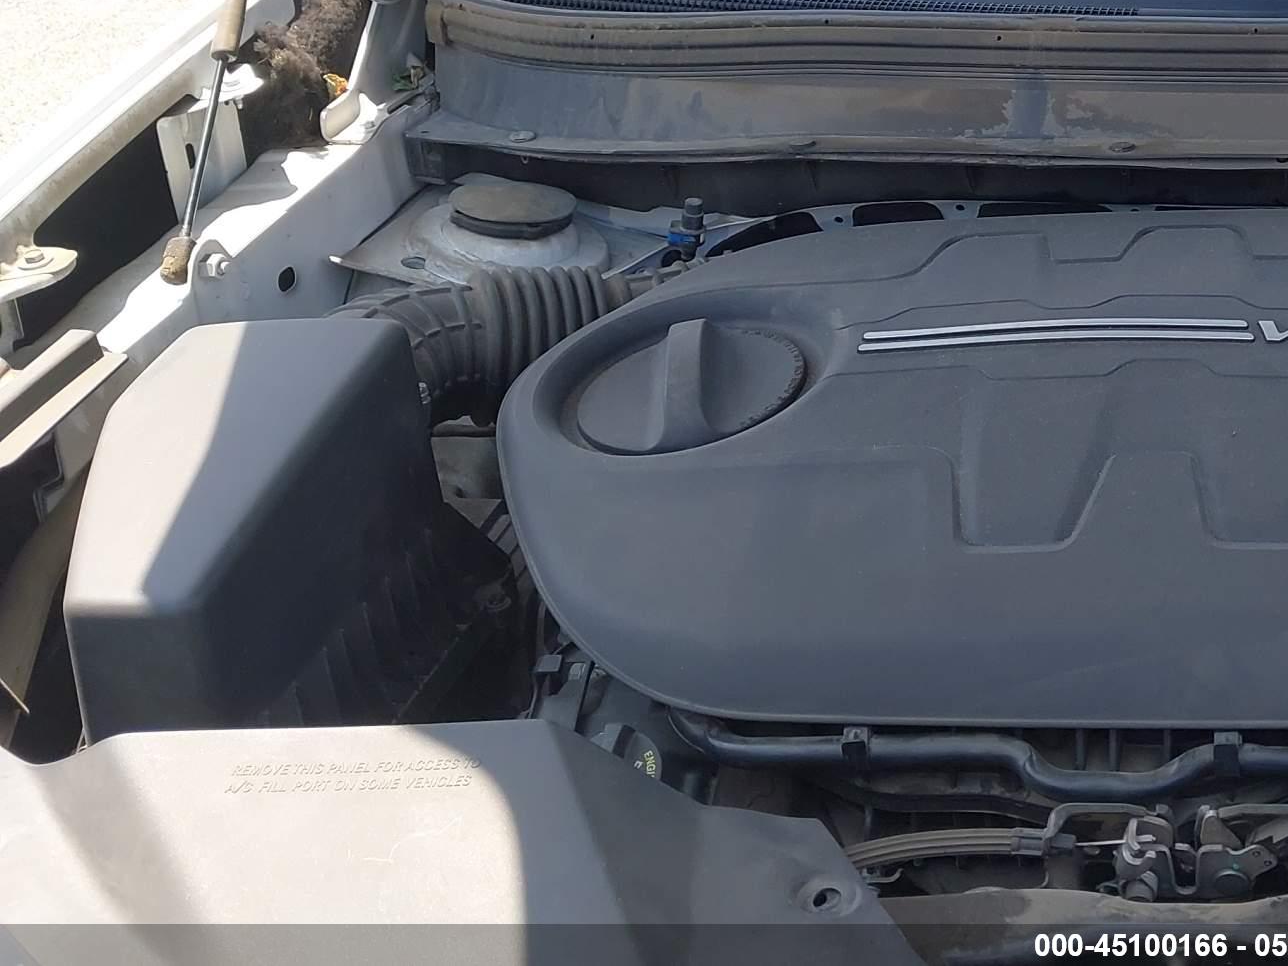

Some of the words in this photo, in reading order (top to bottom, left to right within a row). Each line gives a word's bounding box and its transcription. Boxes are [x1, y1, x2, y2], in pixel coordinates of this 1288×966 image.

[231, 762, 291, 777] REMOVE
[293, 762, 325, 776] THIS
[327, 761, 370, 775] PANEL
[374, 759, 404, 773] FOR
[404, 757, 460, 772] ACCESS
[462, 757, 482, 770] TO
[643, 750, 656, 778] ENGI
[258, 780, 287, 794] FILL
[292, 778, 332, 793] PORT
[334, 778, 357, 792] ON
[358, 776, 401, 791] SOME
[404, 774, 473, 790] VEHICLES
